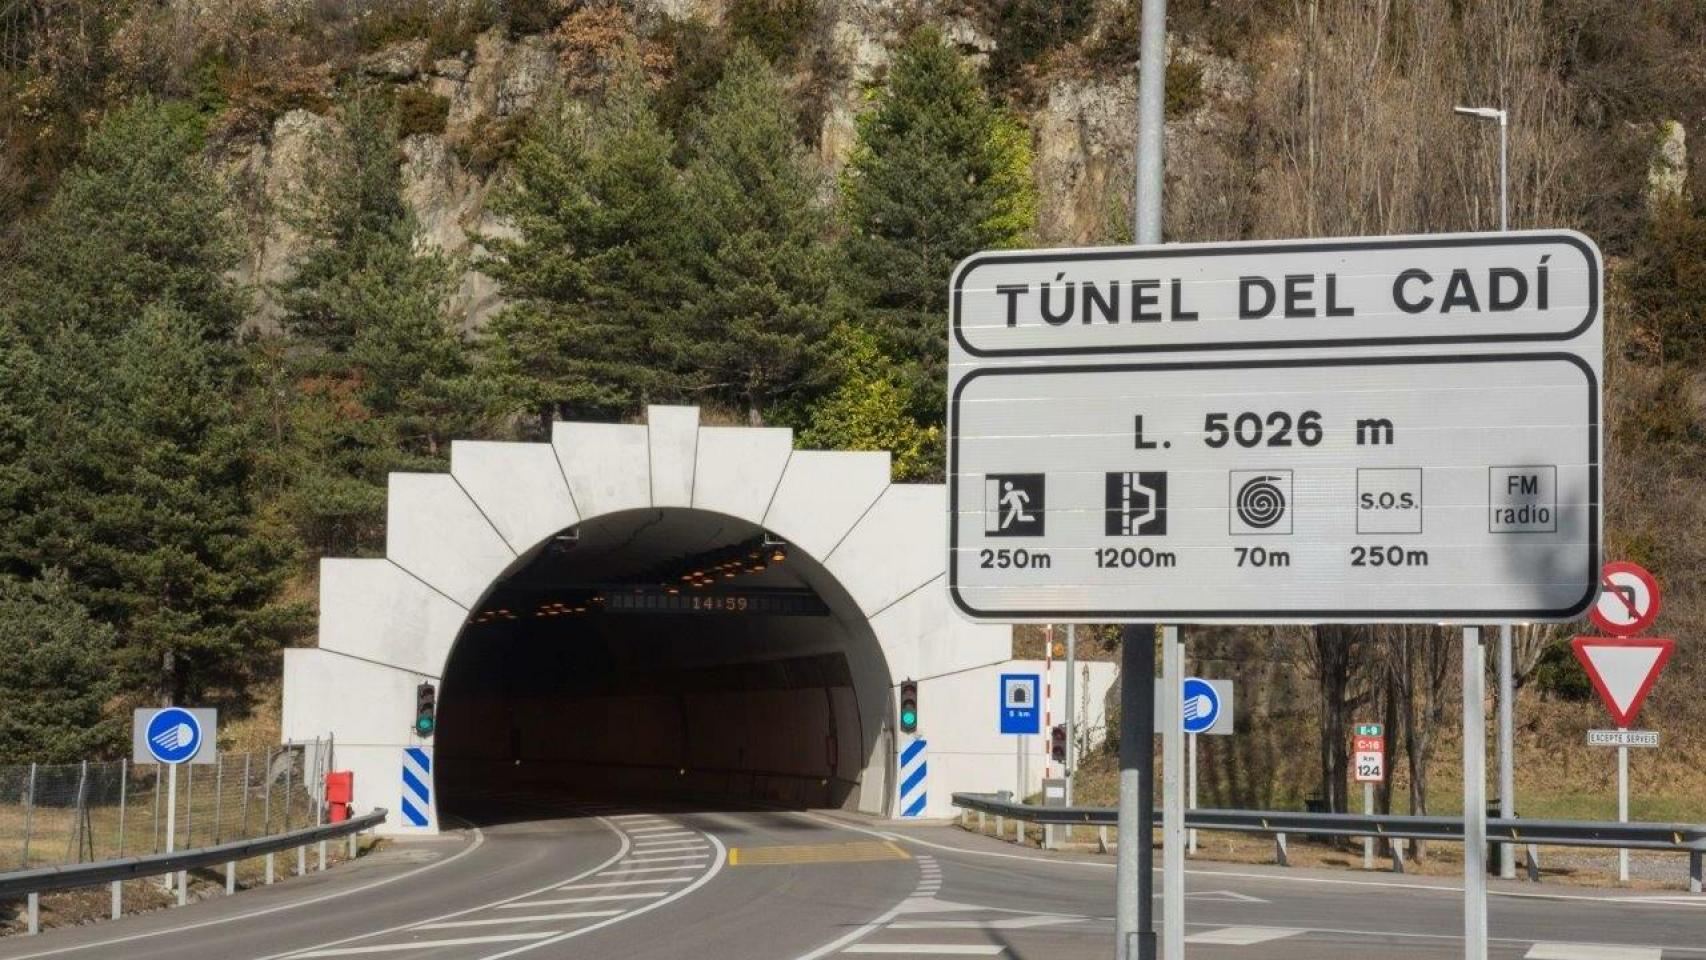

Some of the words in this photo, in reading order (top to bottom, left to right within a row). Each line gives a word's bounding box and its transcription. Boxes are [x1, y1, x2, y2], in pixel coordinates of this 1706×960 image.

[997, 272, 1199, 328] TÚNEL
[1238, 273, 1355, 320] DEL
[1392, 255, 1551, 314] CADÍ
[1134, 414, 1171, 450] L.
[1204, 410, 1323, 449] 5026
[1356, 418, 1394, 445] m
[1508, 475, 1538, 496] FM
[1360, 491, 1419, 510] S.O.S.
[1496, 504, 1550, 525] radio
[980, 548, 1051, 569] 250m
[1095, 547, 1176, 569] 1200m
[1234, 546, 1290, 568] 70m
[1350, 545, 1429, 567] 250m
[693, 597, 748, 610] 14:59
[1360, 726, 1378, 736] E-9
[1591, 733, 1622, 743] EXCEPTE
[1626, 734, 1656, 744] SERVEIS
[1358, 739, 1380, 749] C-16
[1358, 765, 1380, 777] 124
